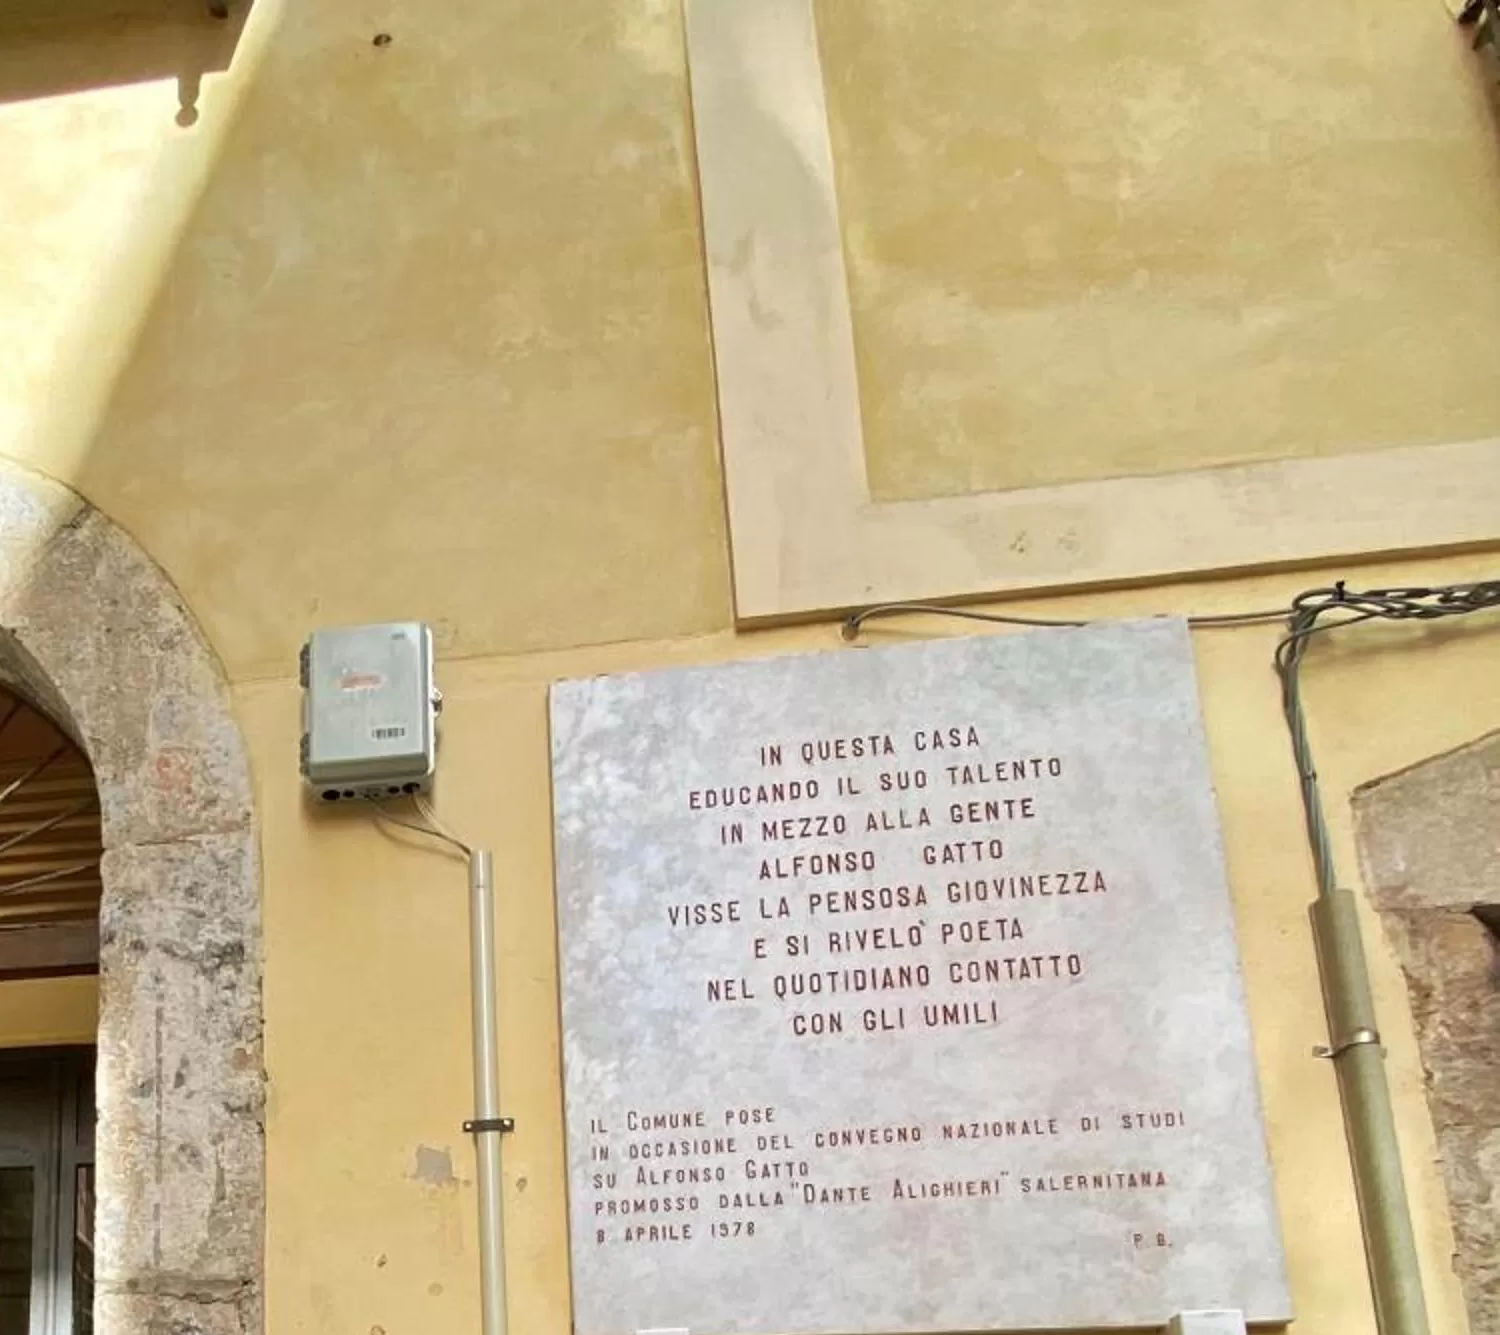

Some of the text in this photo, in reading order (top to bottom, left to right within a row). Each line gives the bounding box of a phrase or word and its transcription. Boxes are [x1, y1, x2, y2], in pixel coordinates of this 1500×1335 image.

[760, 726, 980, 766] IN QUESTA CASA
[689, 757, 1062, 810] EDUCANDO IL SUO TALENTO
[720, 797, 1036, 845] IN MEZZO ALLA GENTE
[759, 838, 1004, 880] ALFONSO GATTO
[668, 870, 1107, 927] VISSE LA PENSOSA GIOVINEZZA
[754, 938, 767, 959] E
[787, 935, 809, 957] SI
[941, 917, 1024, 944] POETA
[707, 954, 1081, 1002] NEL QUOTIDIANO CONTATTO
[793, 1000, 998, 1036] CON GLI UMILI
[591, 1119, 608, 1134] IL
[725, 1107, 775, 1126] POSE
[591, 1110, 1185, 1161] IN OCCASIONE DEL CONVEGNO NAZIONALE DI STUDI
[593, 1159, 809, 1189] SU ALFONSO GATTO
[595, 1196, 700, 1216] PROMOSSO
[719, 1191, 784, 1209] DALLA
[1020, 1171, 1168, 1193] SALERNITANA
[625, 1223, 693, 1242] APRILE
[711, 1221, 756, 1238] 1978
